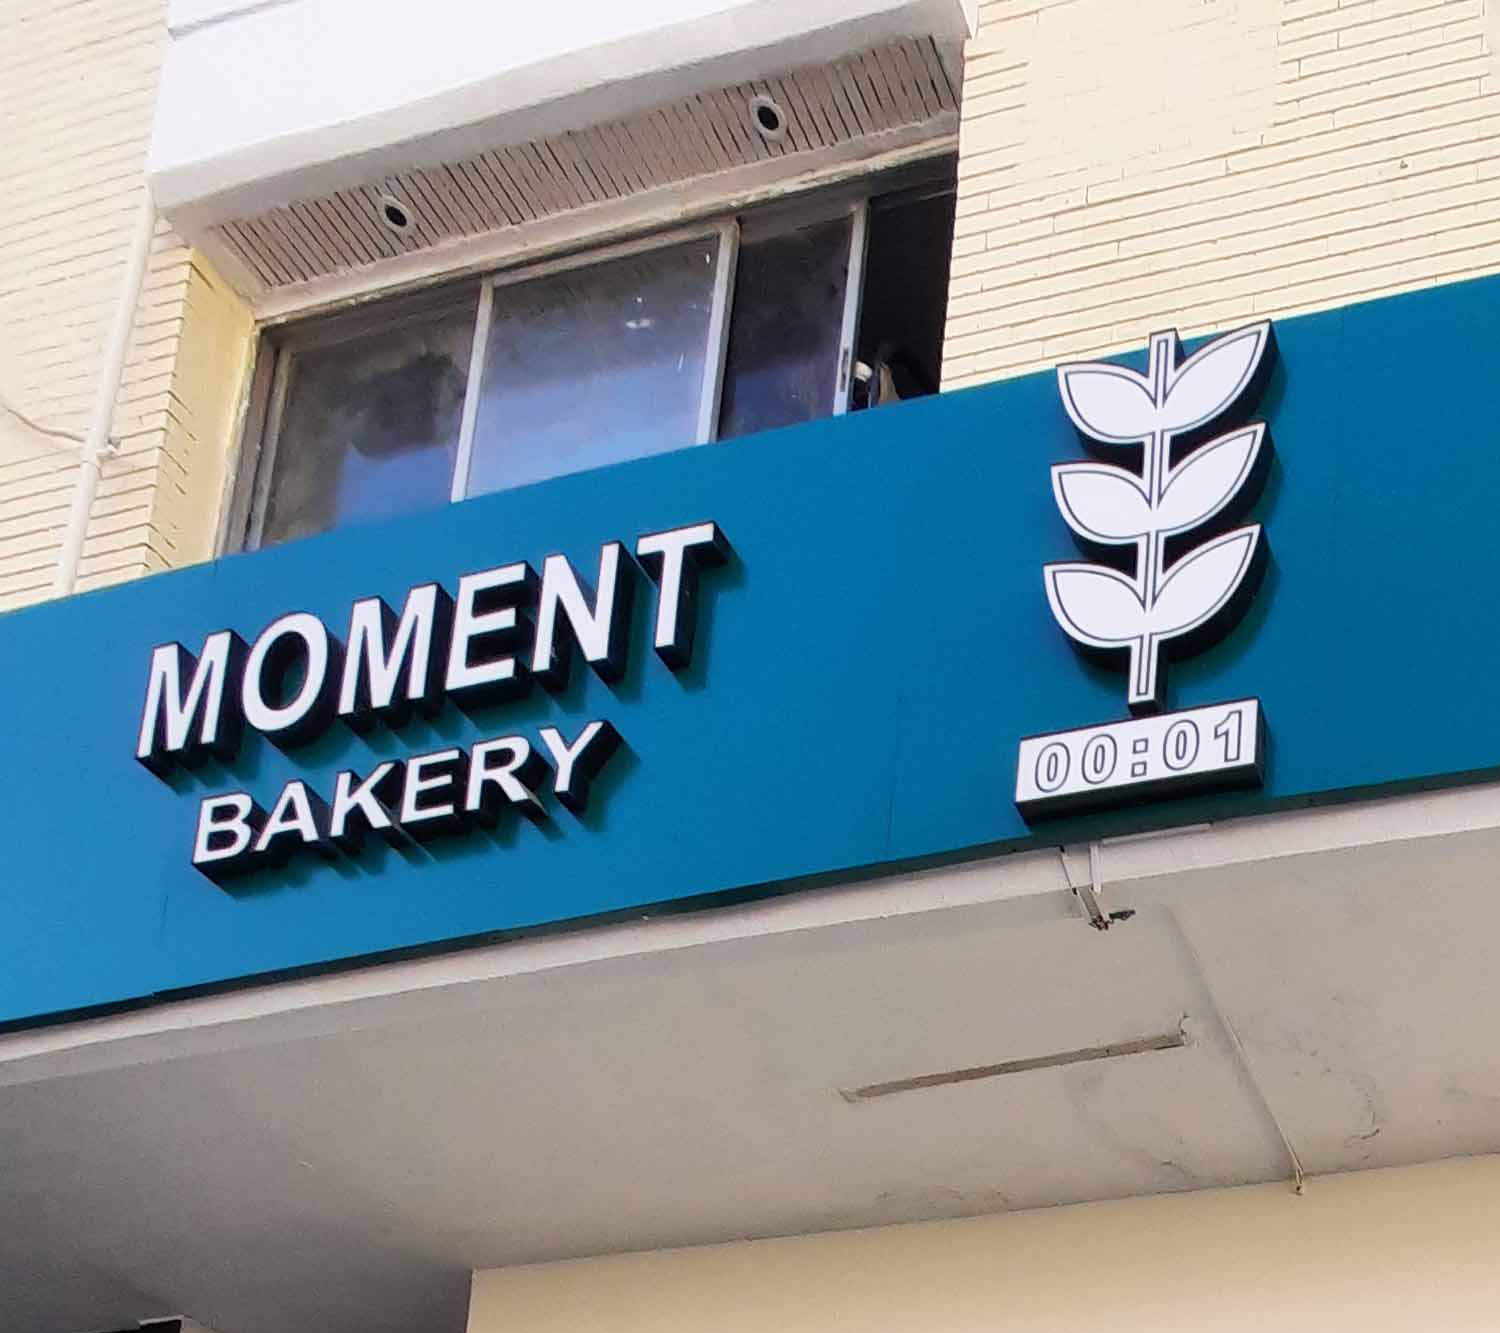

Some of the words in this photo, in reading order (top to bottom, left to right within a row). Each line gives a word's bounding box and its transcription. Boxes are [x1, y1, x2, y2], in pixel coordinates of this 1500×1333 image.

[137, 523, 714, 758] MOMENT
[192, 722, 603, 864] BAKERY
[1035, 710, 1242, 792] 00:01
